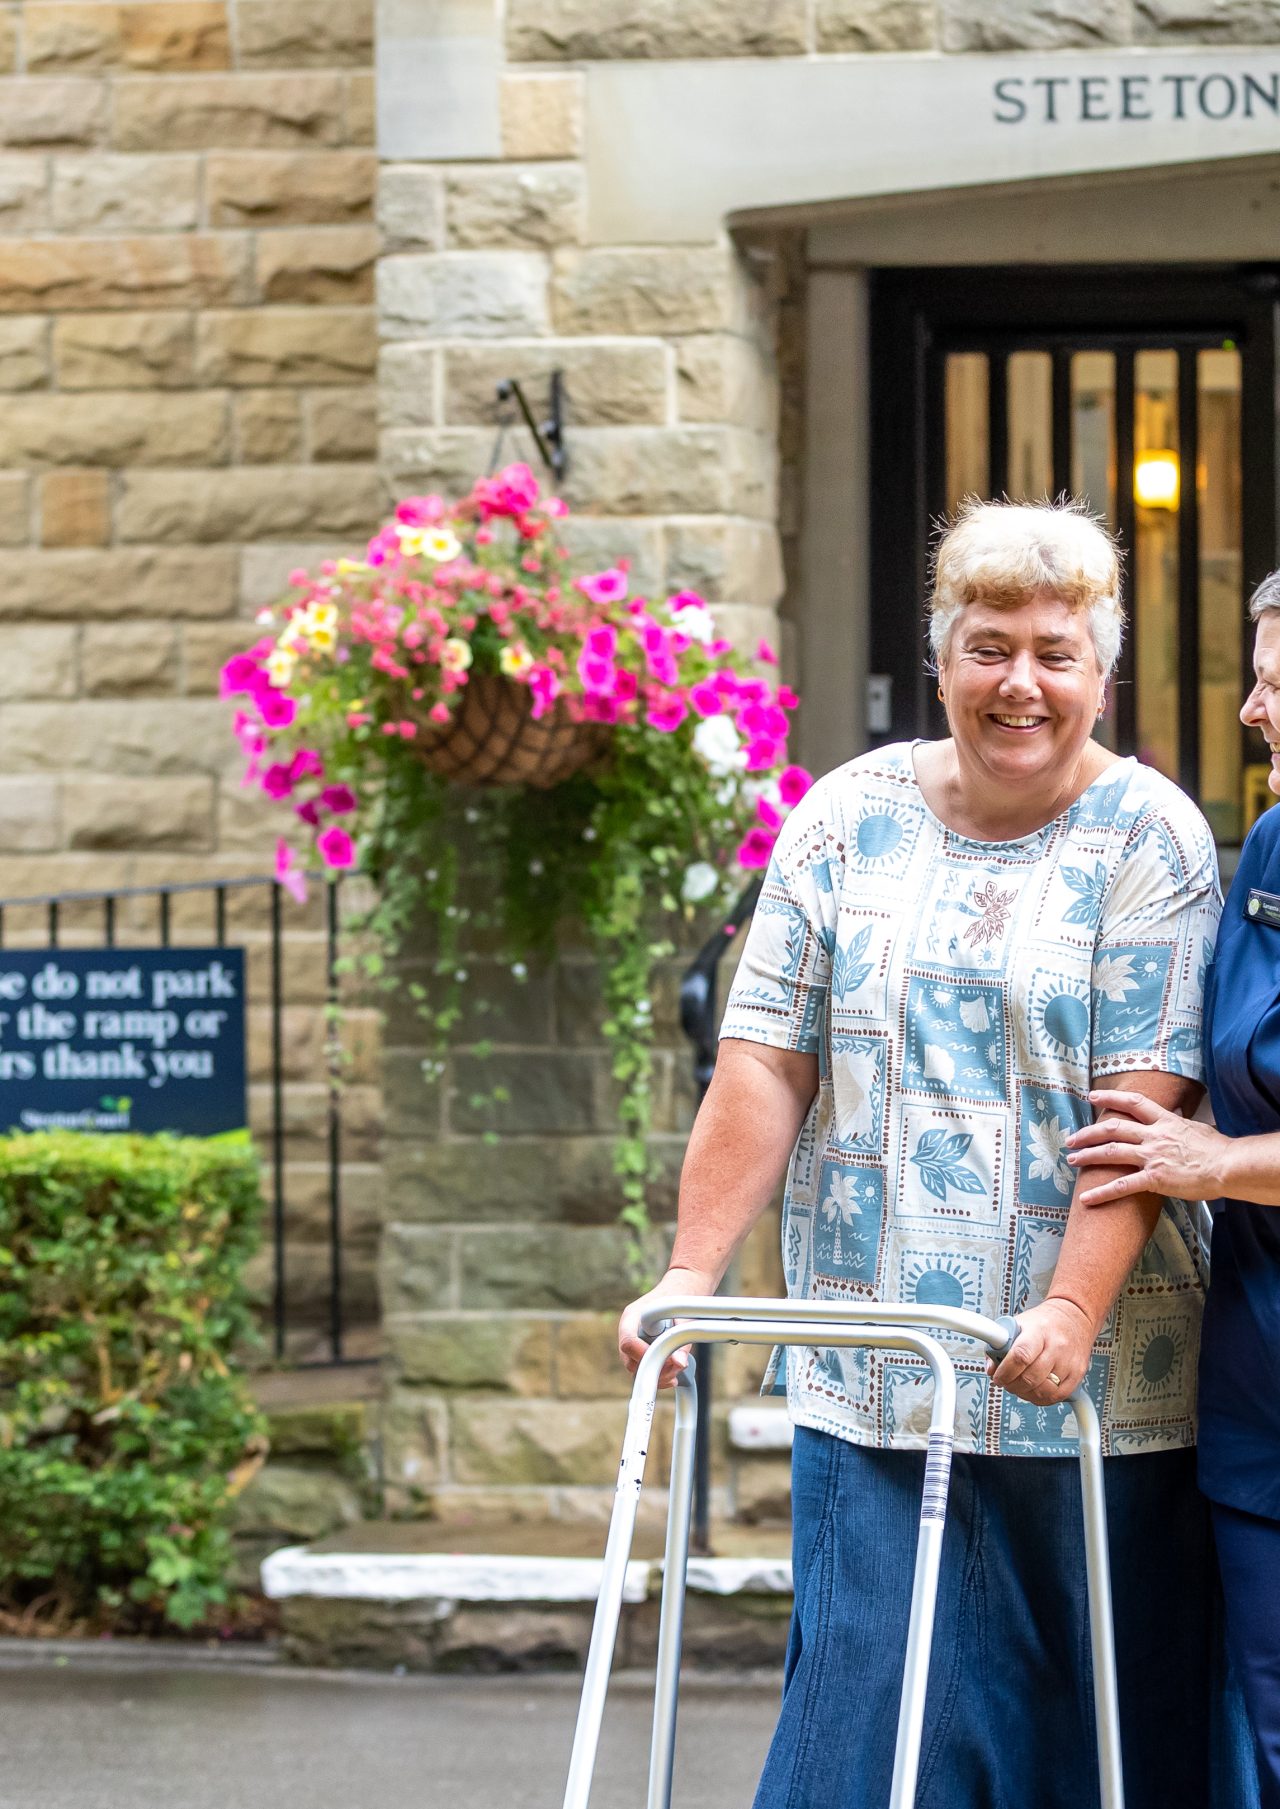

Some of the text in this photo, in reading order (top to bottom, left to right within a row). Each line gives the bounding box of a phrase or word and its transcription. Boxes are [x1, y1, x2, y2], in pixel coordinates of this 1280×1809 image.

[992, 72, 1280, 124] STEETON
[32, 962, 80, 1000] do
[86, 965, 144, 1000] not
[152, 961, 237, 1008] park
[17, 1002, 77, 1041] the
[83, 1010, 180, 1049] ramp
[184, 1010, 229, 1039] or
[43, 1042, 147, 1080] thank
[149, 1050, 215, 1088] you
